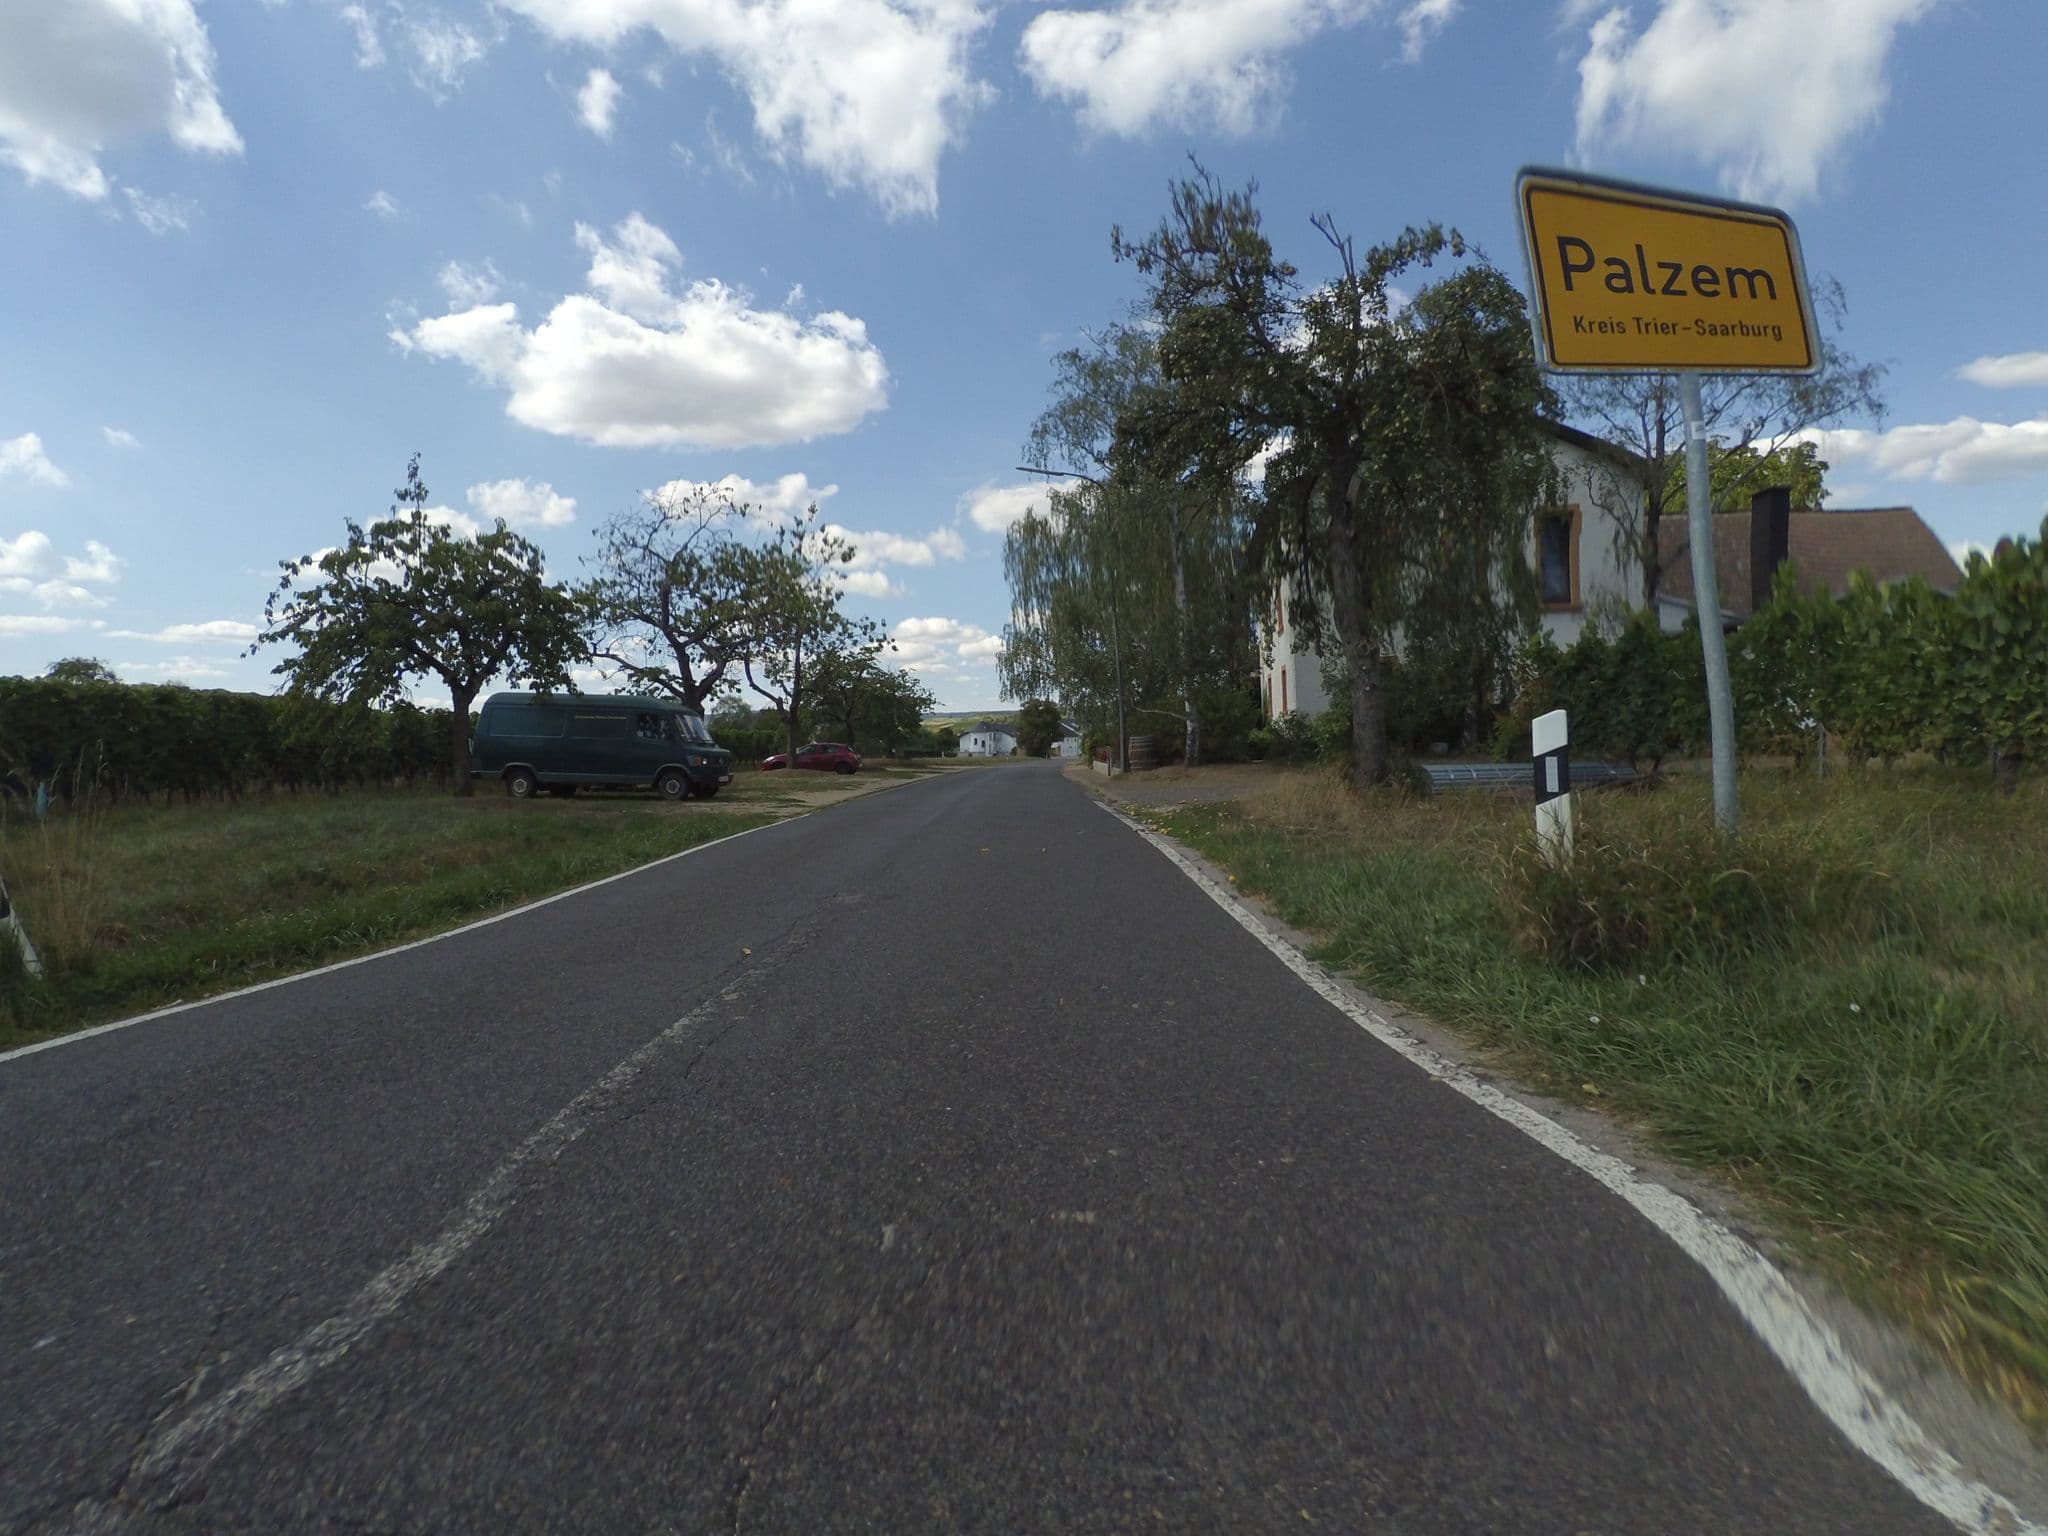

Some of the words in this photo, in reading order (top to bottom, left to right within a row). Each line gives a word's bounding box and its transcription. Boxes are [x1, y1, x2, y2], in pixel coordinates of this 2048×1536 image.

[1557, 235, 1777, 300] Palzem
[1573, 314, 1627, 334] Kreis
[1632, 316, 1783, 341] Trier-Saarburg
